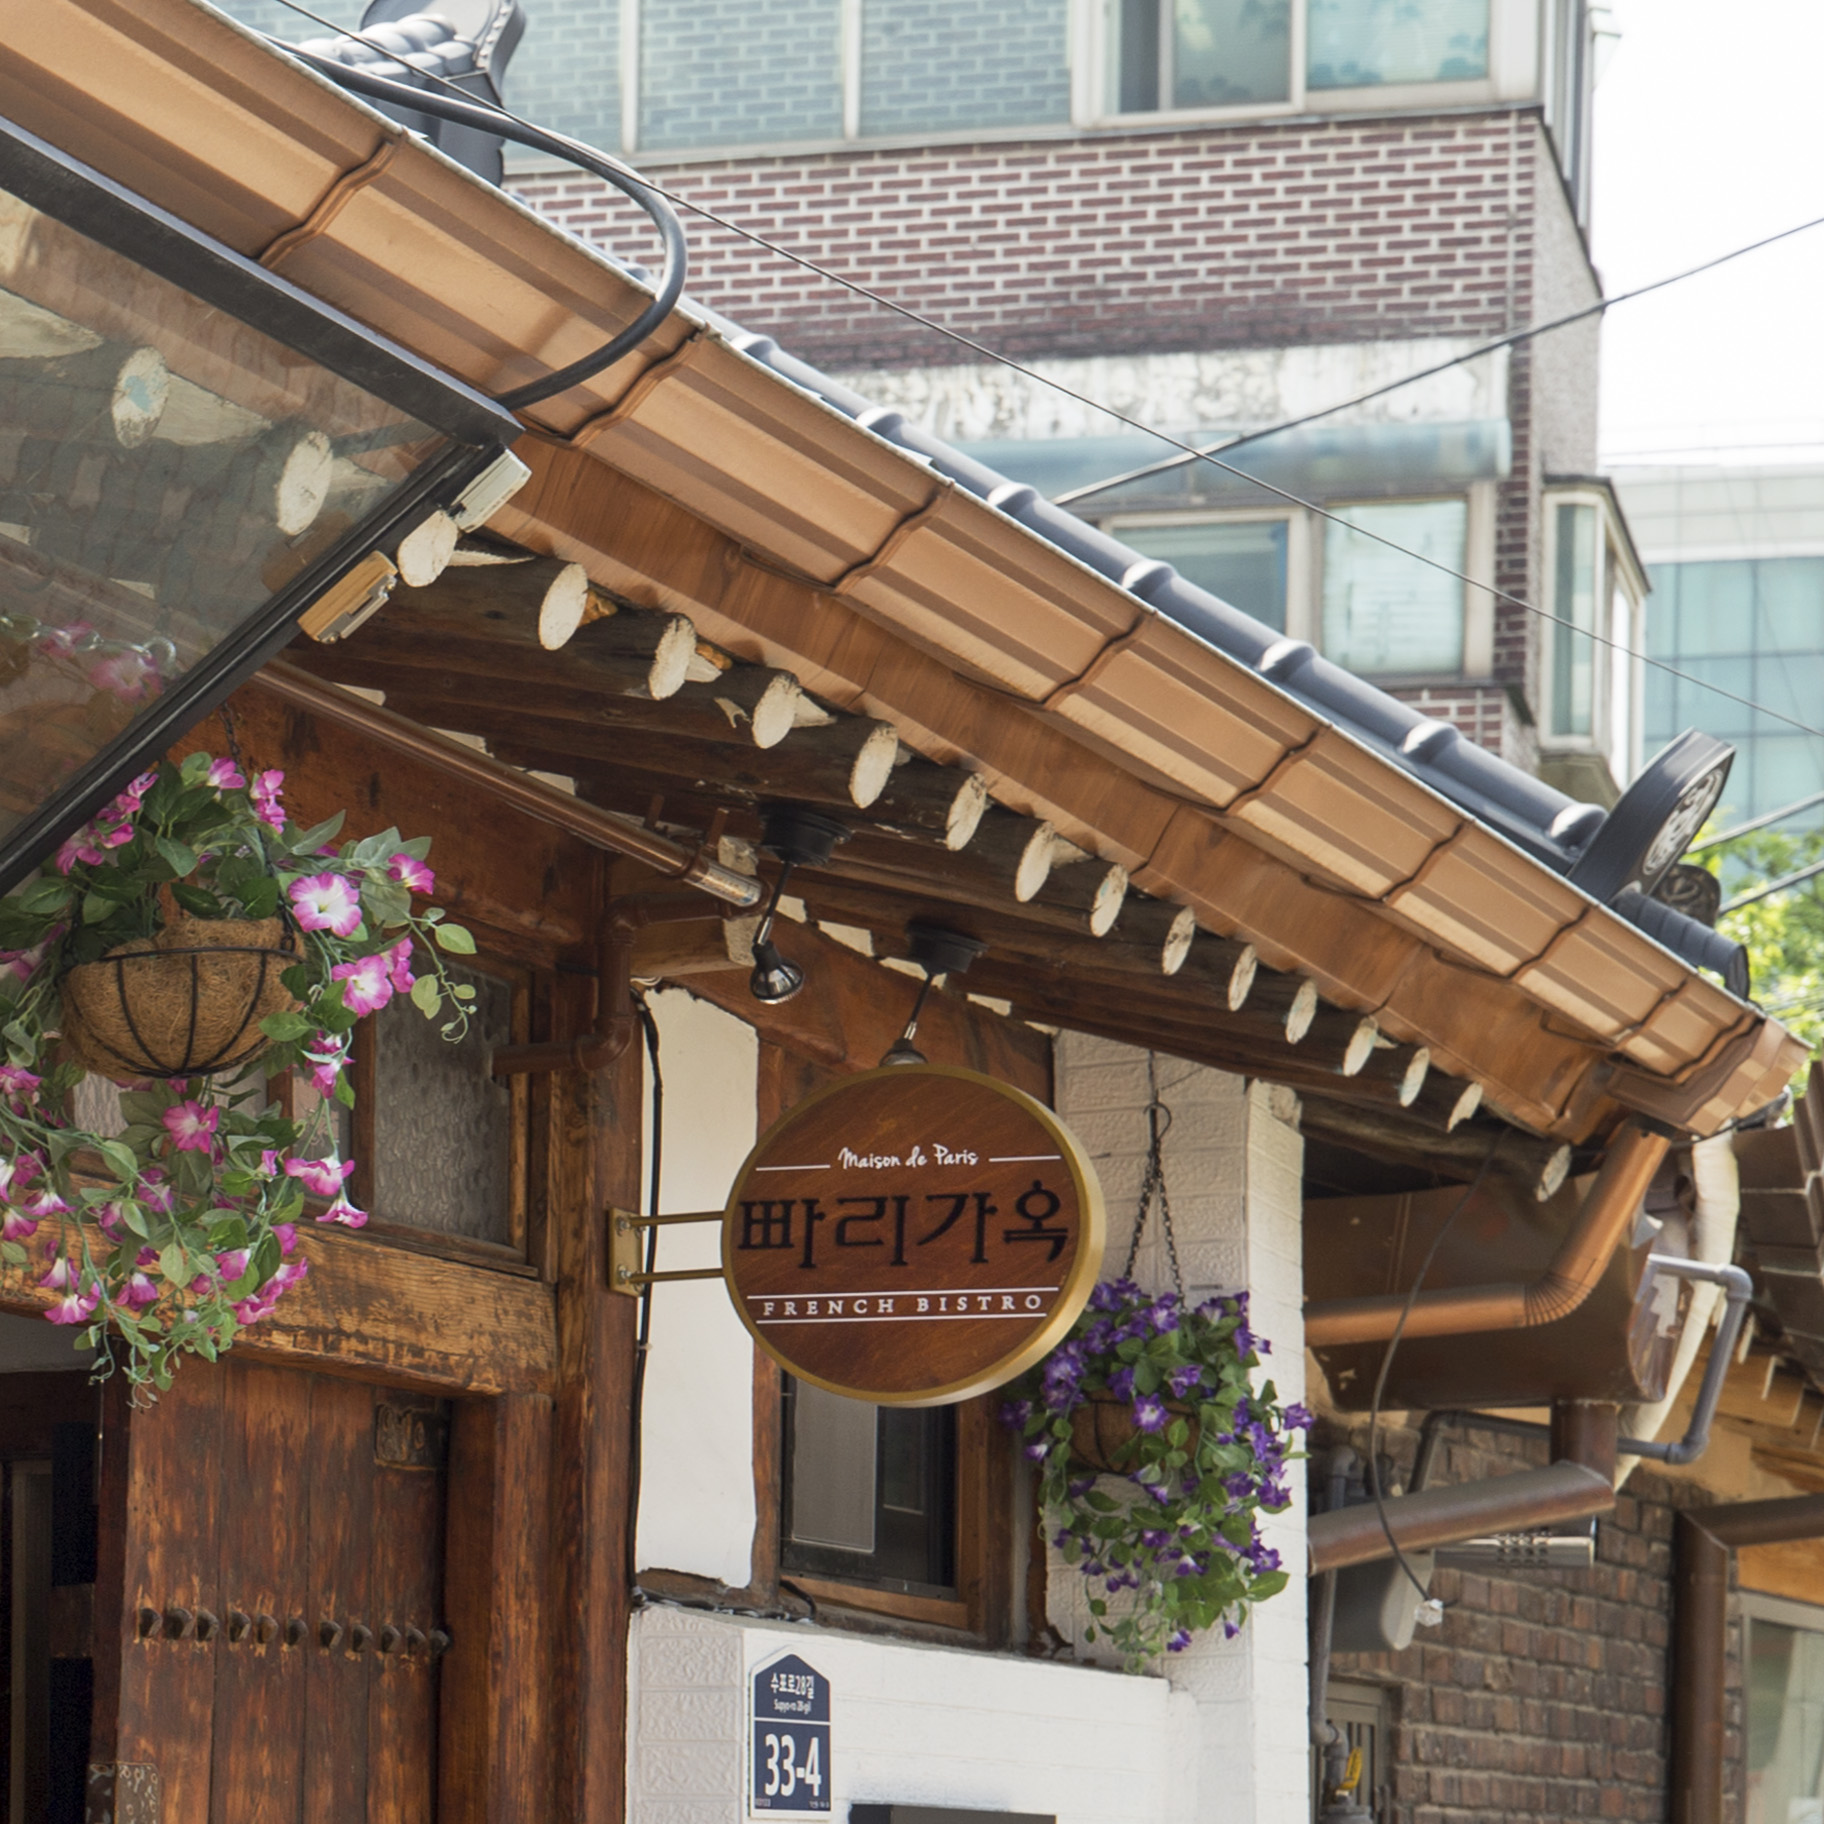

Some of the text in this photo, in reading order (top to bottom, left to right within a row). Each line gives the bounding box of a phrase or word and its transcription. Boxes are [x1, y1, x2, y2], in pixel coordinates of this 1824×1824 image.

[837, 1143, 979, 1170] Maison de Paris
[737, 1179, 1068, 1269] 빠리가옥
[762, 1295, 1042, 1316] FRENCH BISTRO
[765, 1733, 822, 1797] 33-4
